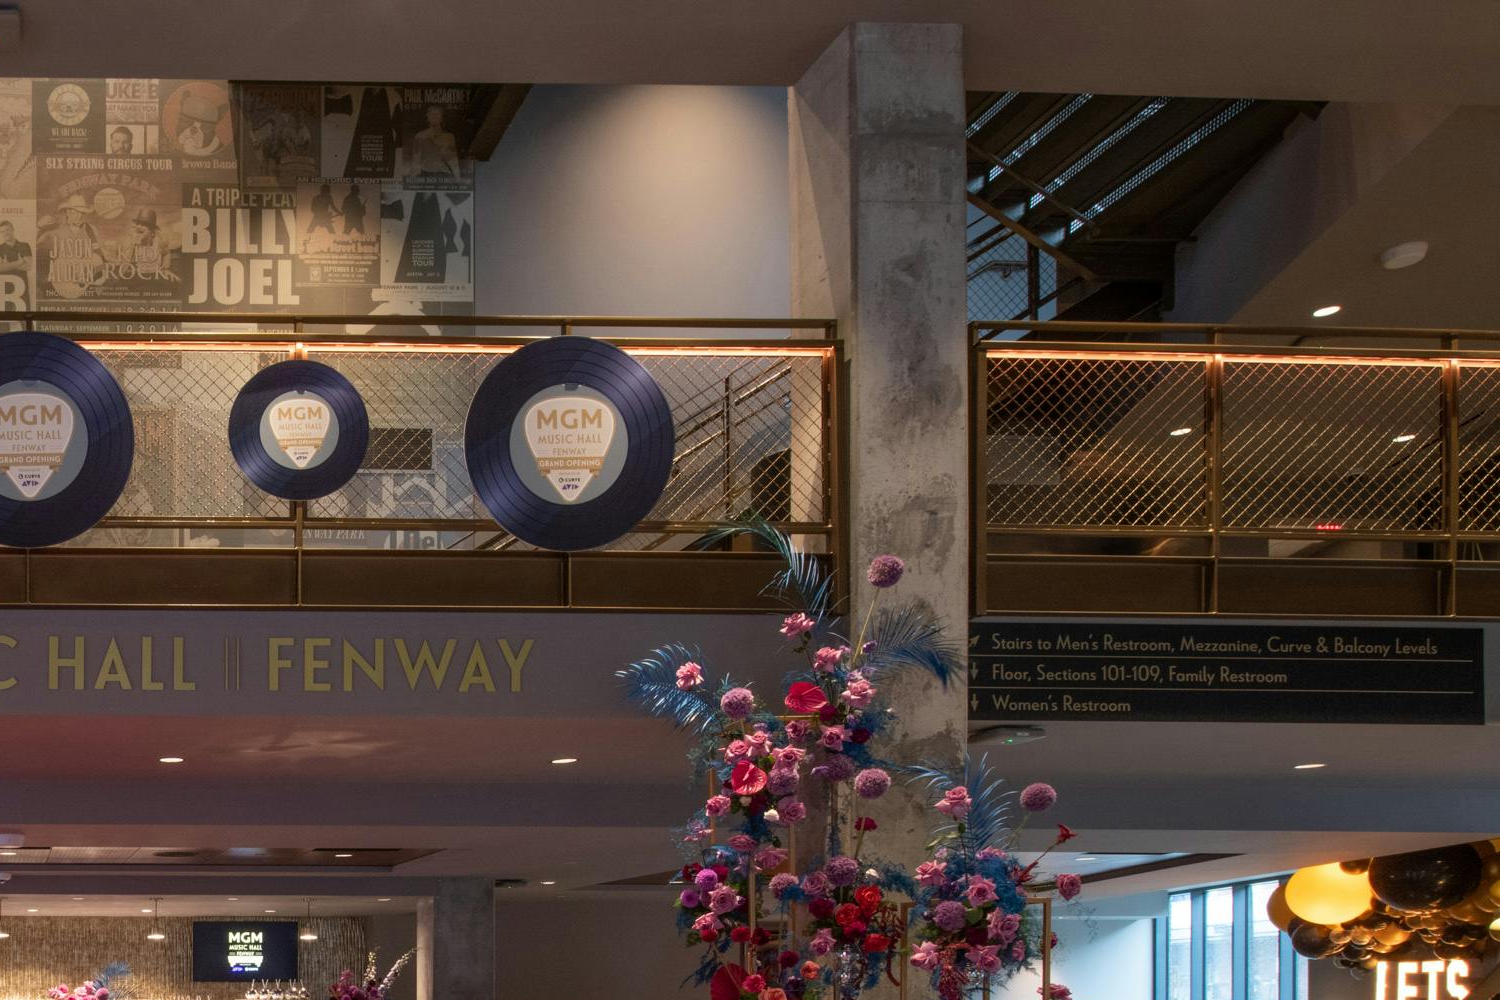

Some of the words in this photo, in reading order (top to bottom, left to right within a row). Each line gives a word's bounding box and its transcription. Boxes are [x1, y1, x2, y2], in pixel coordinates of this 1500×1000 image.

[46, 158, 64, 170] SIX
[66, 158, 105, 170] STRING
[107, 158, 143, 170] CIRCUS
[145, 158, 173, 171] TOUR
[191, 187, 202, 206] A
[206, 187, 258, 207] TRIPLE
[181, 207, 298, 255] BILLY
[49, 235, 93, 260] JASON
[103, 261, 168, 282] ROCK
[187, 257, 301, 306] JOEL
[277, 406, 322, 420] MGM
[536, 408, 603, 430] MGM
[36, 430, 62, 440] HALL
[278, 423, 303, 431] MUSIC
[538, 434, 573, 445] MUSIC
[576, 434, 603, 444] HALL
[12, 444, 47, 452] FENWAY
[552, 447, 587, 455] FENWAY
[25, 455, 61, 463] OPENING
[566, 459, 601, 467] OPENING
[991, 634, 1032, 650] Stairs
[1037, 637, 1053, 651] to
[1056, 634, 1099, 652] Men's
[1103, 636, 1176, 654] Restroom,
[1180, 637, 1262, 654] Mezzanine,
[1266, 637, 1312, 654] Curve
[1316, 638, 1330, 654] &
[1334, 637, 1391, 657] Balcony
[1395, 639, 1438, 655] Levels
[47, 635, 197, 692] HALL
[268, 637, 535, 693] FENWAY
[991, 664, 1032, 683] Floor,
[1036, 664, 1097, 682] Sections
[1101, 665, 1164, 684] 101-109,
[1168, 666, 1216, 687] Family
[1220, 668, 1288, 684] Restroom
[991, 695, 1059, 712] Women's
[1063, 696, 1132, 713] Restroom
[228, 931, 263, 944] MGM
